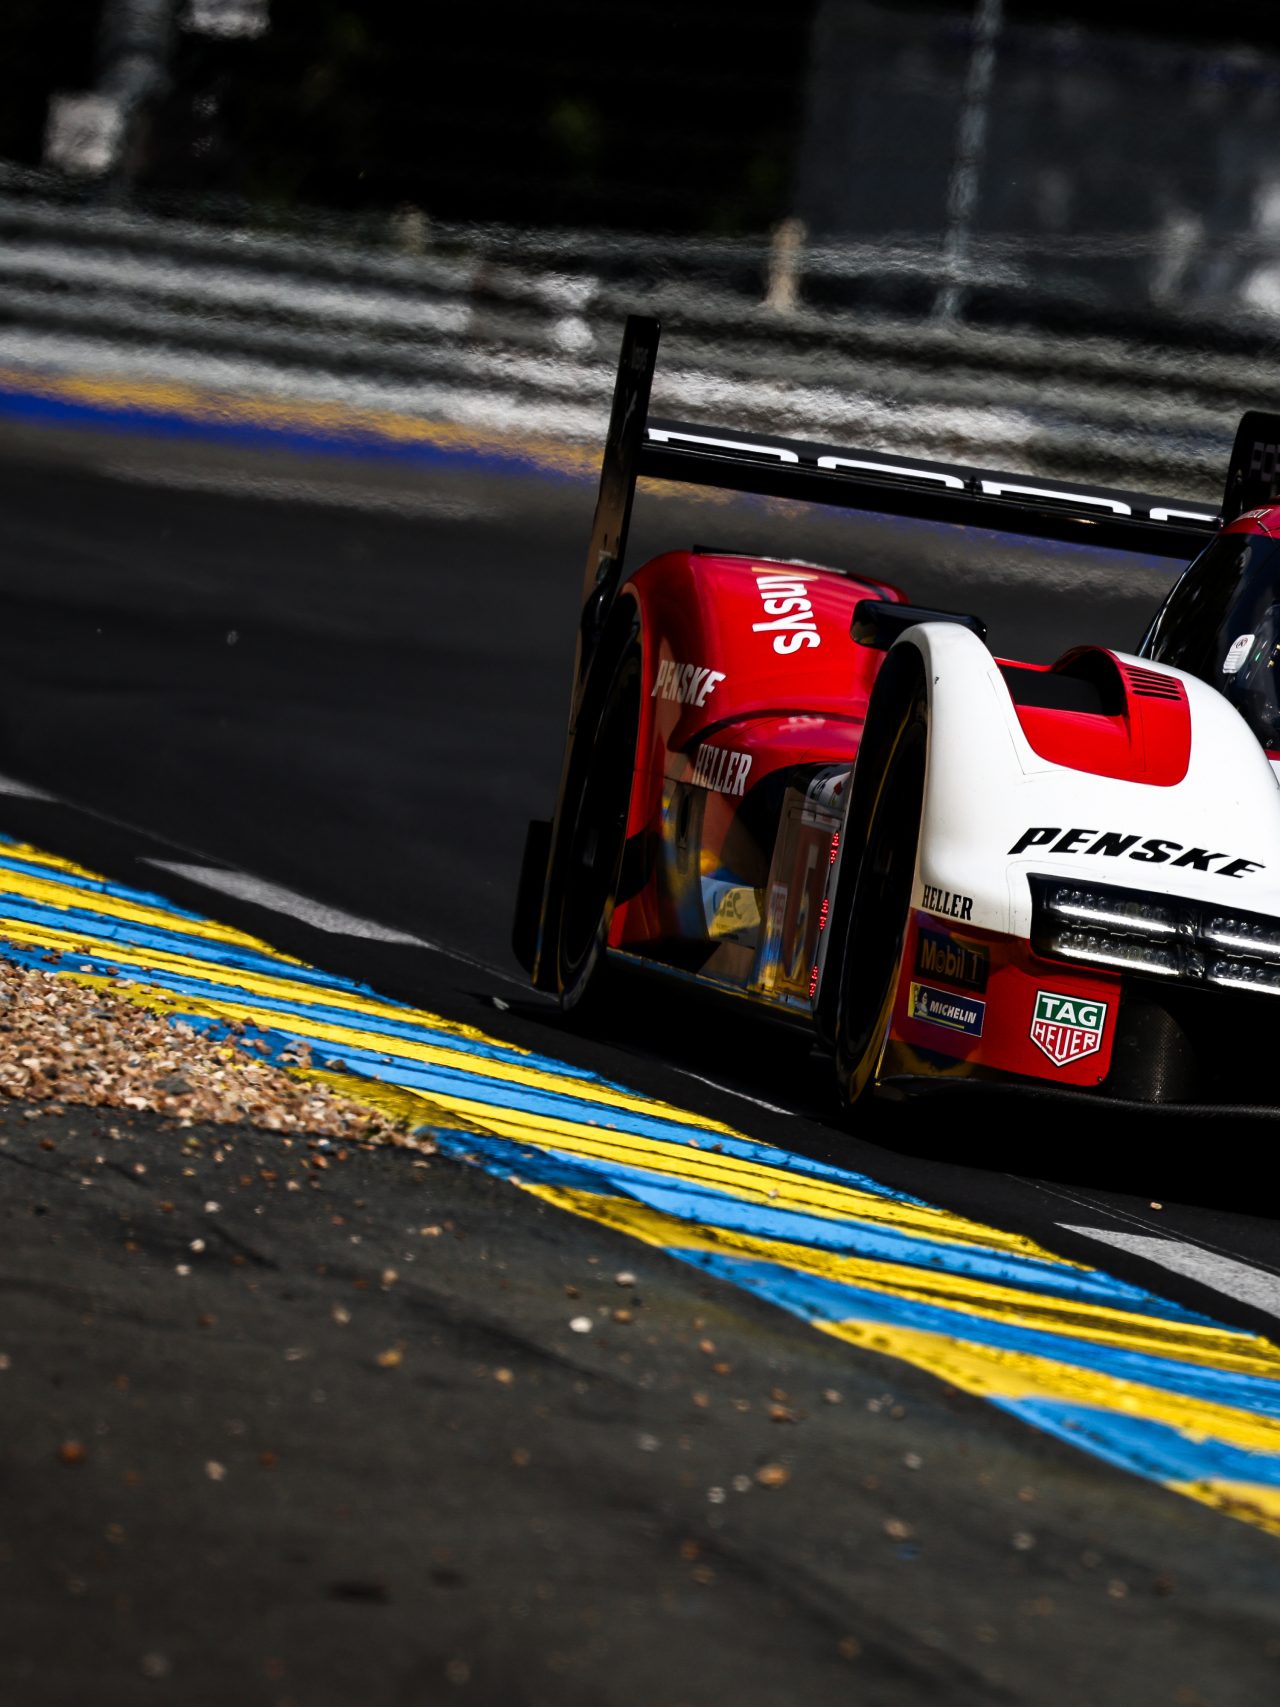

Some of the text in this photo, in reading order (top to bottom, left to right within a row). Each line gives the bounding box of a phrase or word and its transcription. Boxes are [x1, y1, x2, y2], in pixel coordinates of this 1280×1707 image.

[751, 566, 822, 655] Ansys
[650, 659, 727, 708] PENSKE
[691, 743, 753, 797] HELLER
[1006, 827, 1267, 879] PENSKE
[921, 884, 974, 921] HELLER
[920, 937, 966, 981] Mobil
[929, 1000, 977, 1025] MICHELIN
[1042, 997, 1098, 1028] TAG
[1034, 1022, 1097, 1061] HEUER
